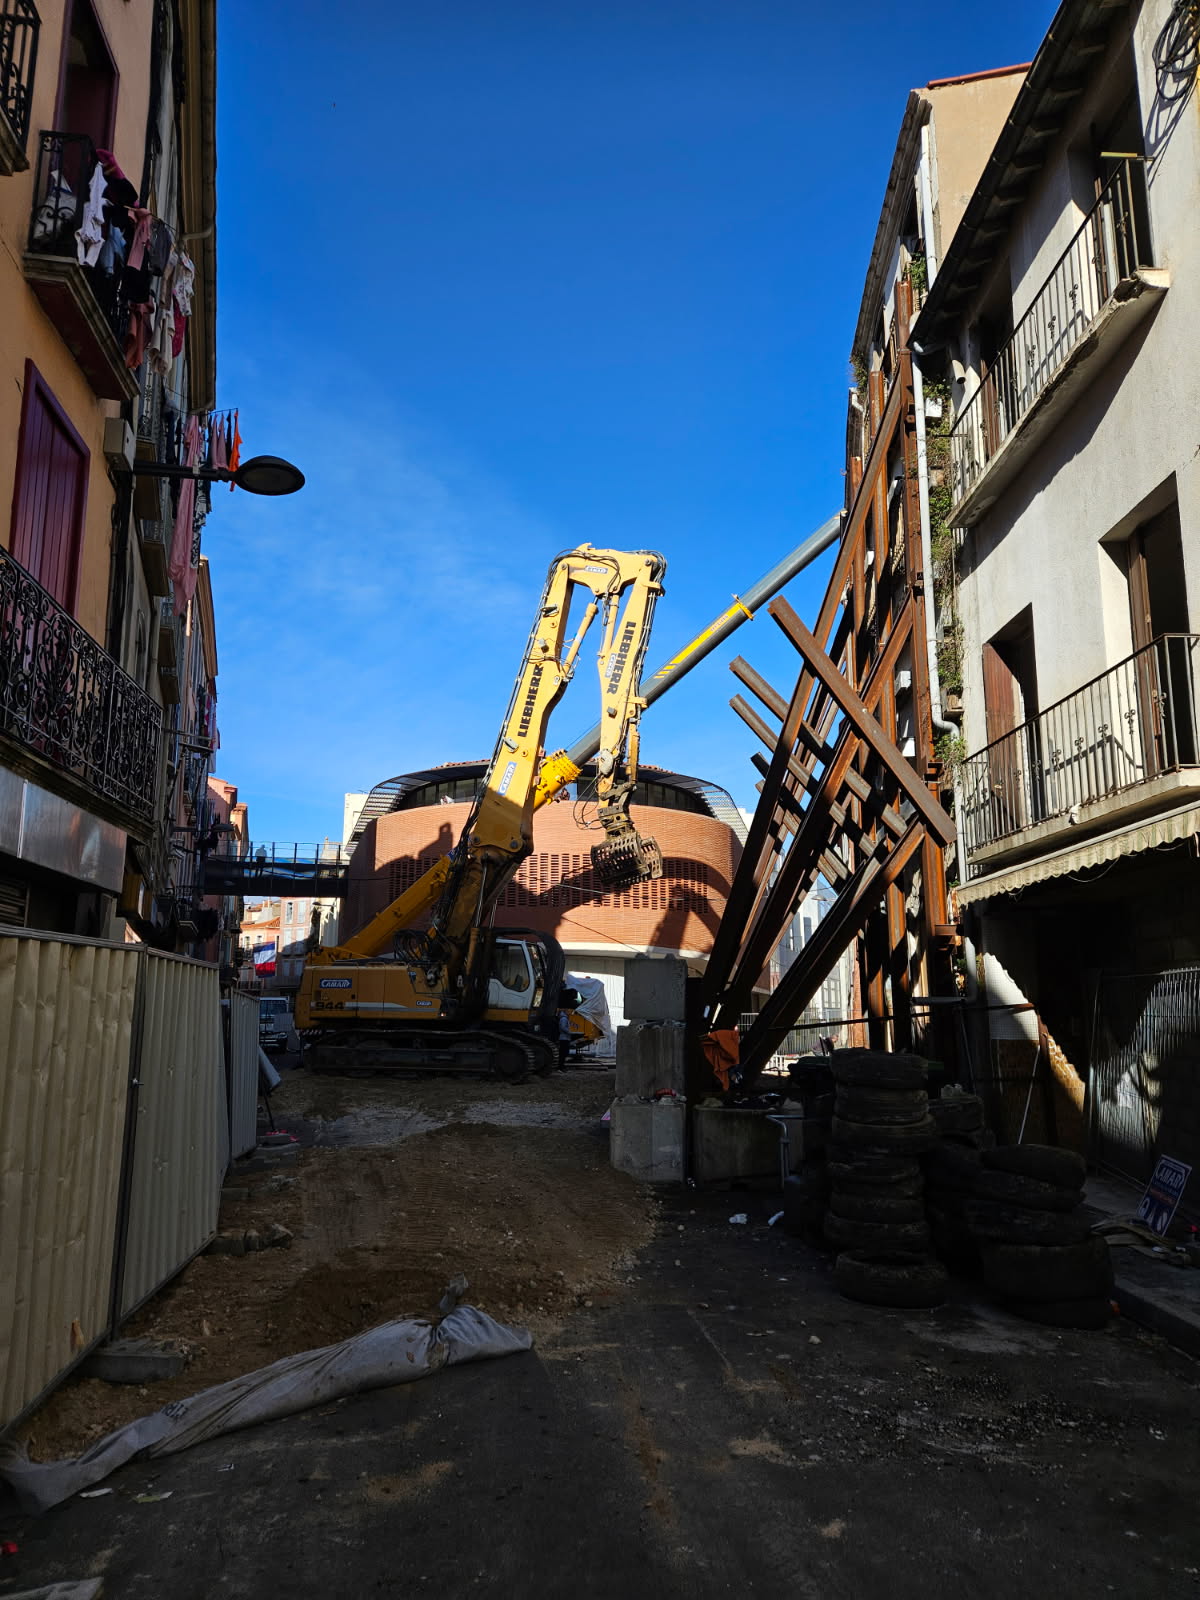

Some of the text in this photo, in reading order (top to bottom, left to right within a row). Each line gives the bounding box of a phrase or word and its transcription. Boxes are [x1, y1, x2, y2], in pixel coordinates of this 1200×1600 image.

[606, 621, 636, 695] LIEBHERR
[517, 663, 544, 738] LIEBHERR
[316, 1001, 344, 1010] 944
